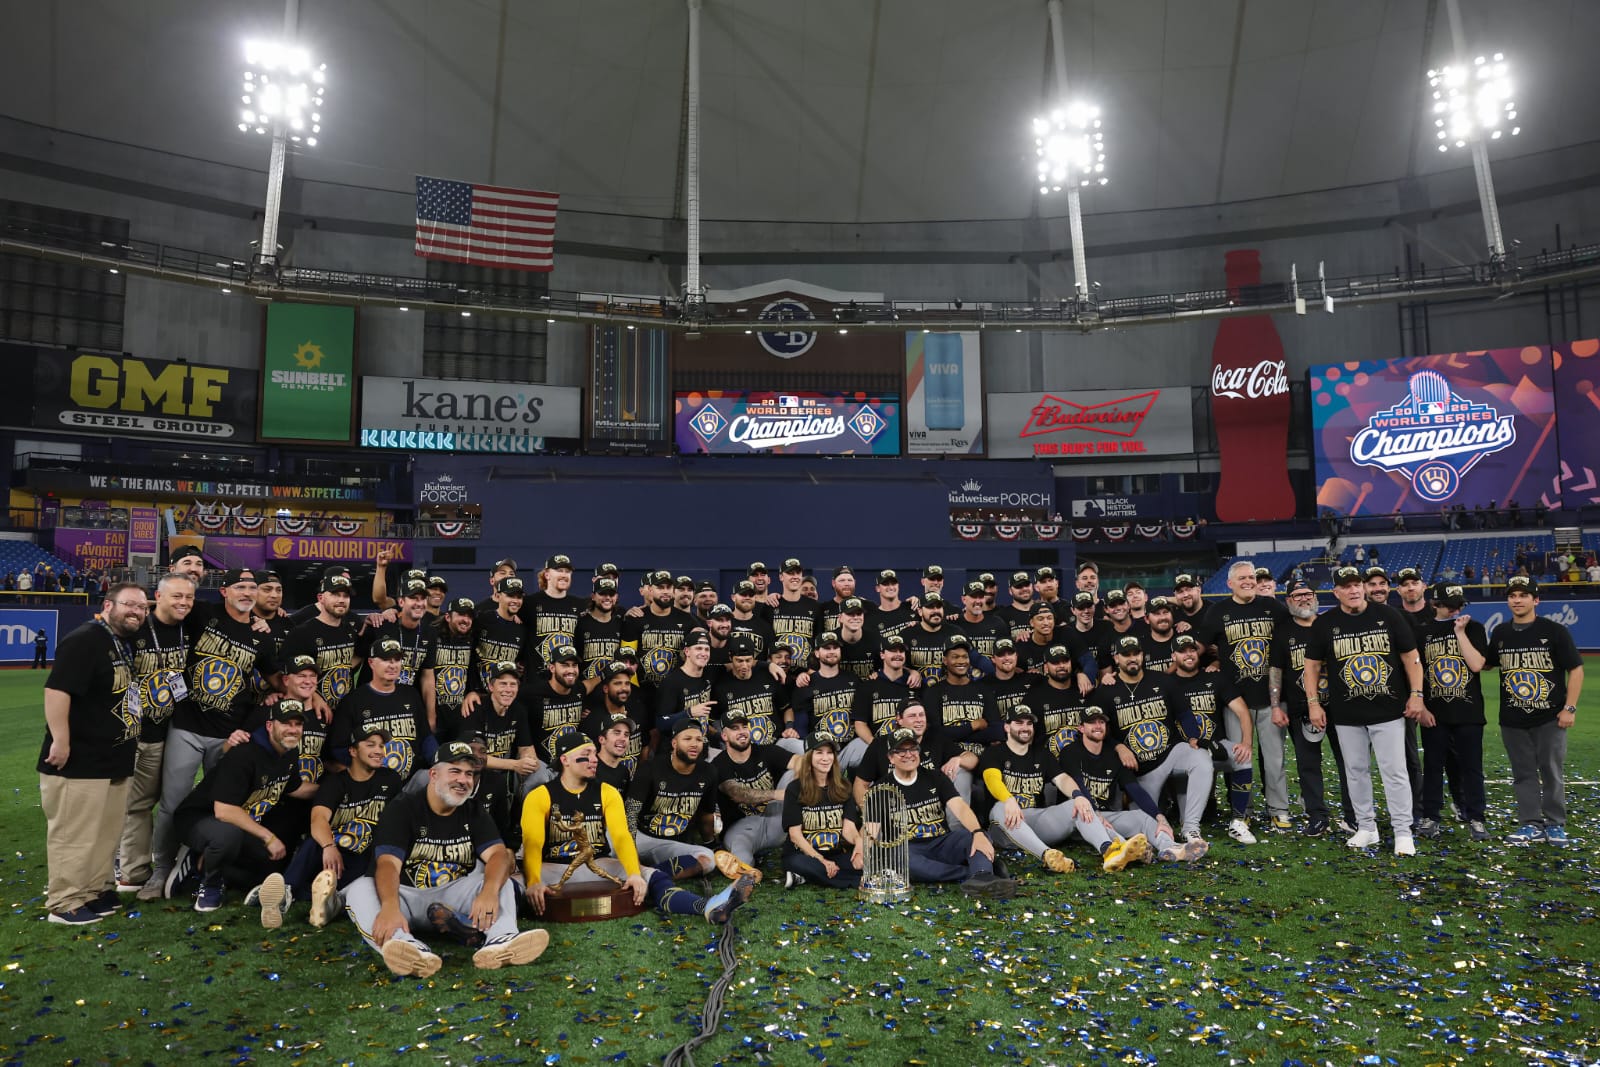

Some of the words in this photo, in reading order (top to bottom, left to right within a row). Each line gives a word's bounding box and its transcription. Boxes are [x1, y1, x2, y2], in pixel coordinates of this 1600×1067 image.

[928, 363, 959, 375] VIVA
[70, 354, 229, 417] GMF
[271, 369, 346, 387] SUNBELT
[1211, 359, 1290, 400] Coca-Cola
[281, 384, 335, 392] RENTALS
[401, 381, 544, 424] kane's
[745, 407, 790, 415] WORLD
[791, 407, 832, 415] SERIES
[1395, 407, 1412, 416] 20
[1451, 403, 1469, 412] 26
[72, 412, 144, 429] STEEL
[153, 419, 223, 435] GROUP
[1031, 405, 1146, 427] Budweiser
[1375, 415, 1430, 428] WORLD
[1434, 411, 1492, 424] SERIES
[415, 423, 530, 436] FURNITURE
[728, 415, 845, 445] Champions
[1353, 416, 1514, 462] Champions
[89, 475, 108, 488] WE
[120, 477, 144, 490] THE
[145, 479, 176, 492] RAYS.
[177, 480, 194, 493] WE
[217, 483, 234, 496] ST.
[235, 484, 261, 496] PETE
[424, 483, 466, 491] Budweiser
[420, 490, 468, 502] PORCH
[1000, 492, 1050, 506] PORCH
[134, 521, 155, 531] GOOD
[105, 532, 126, 545] FAN
[299, 535, 363, 559] DAIQUIRI
[75, 544, 125, 558] FAVORITE
[1362, 633, 1391, 652] SERIES
